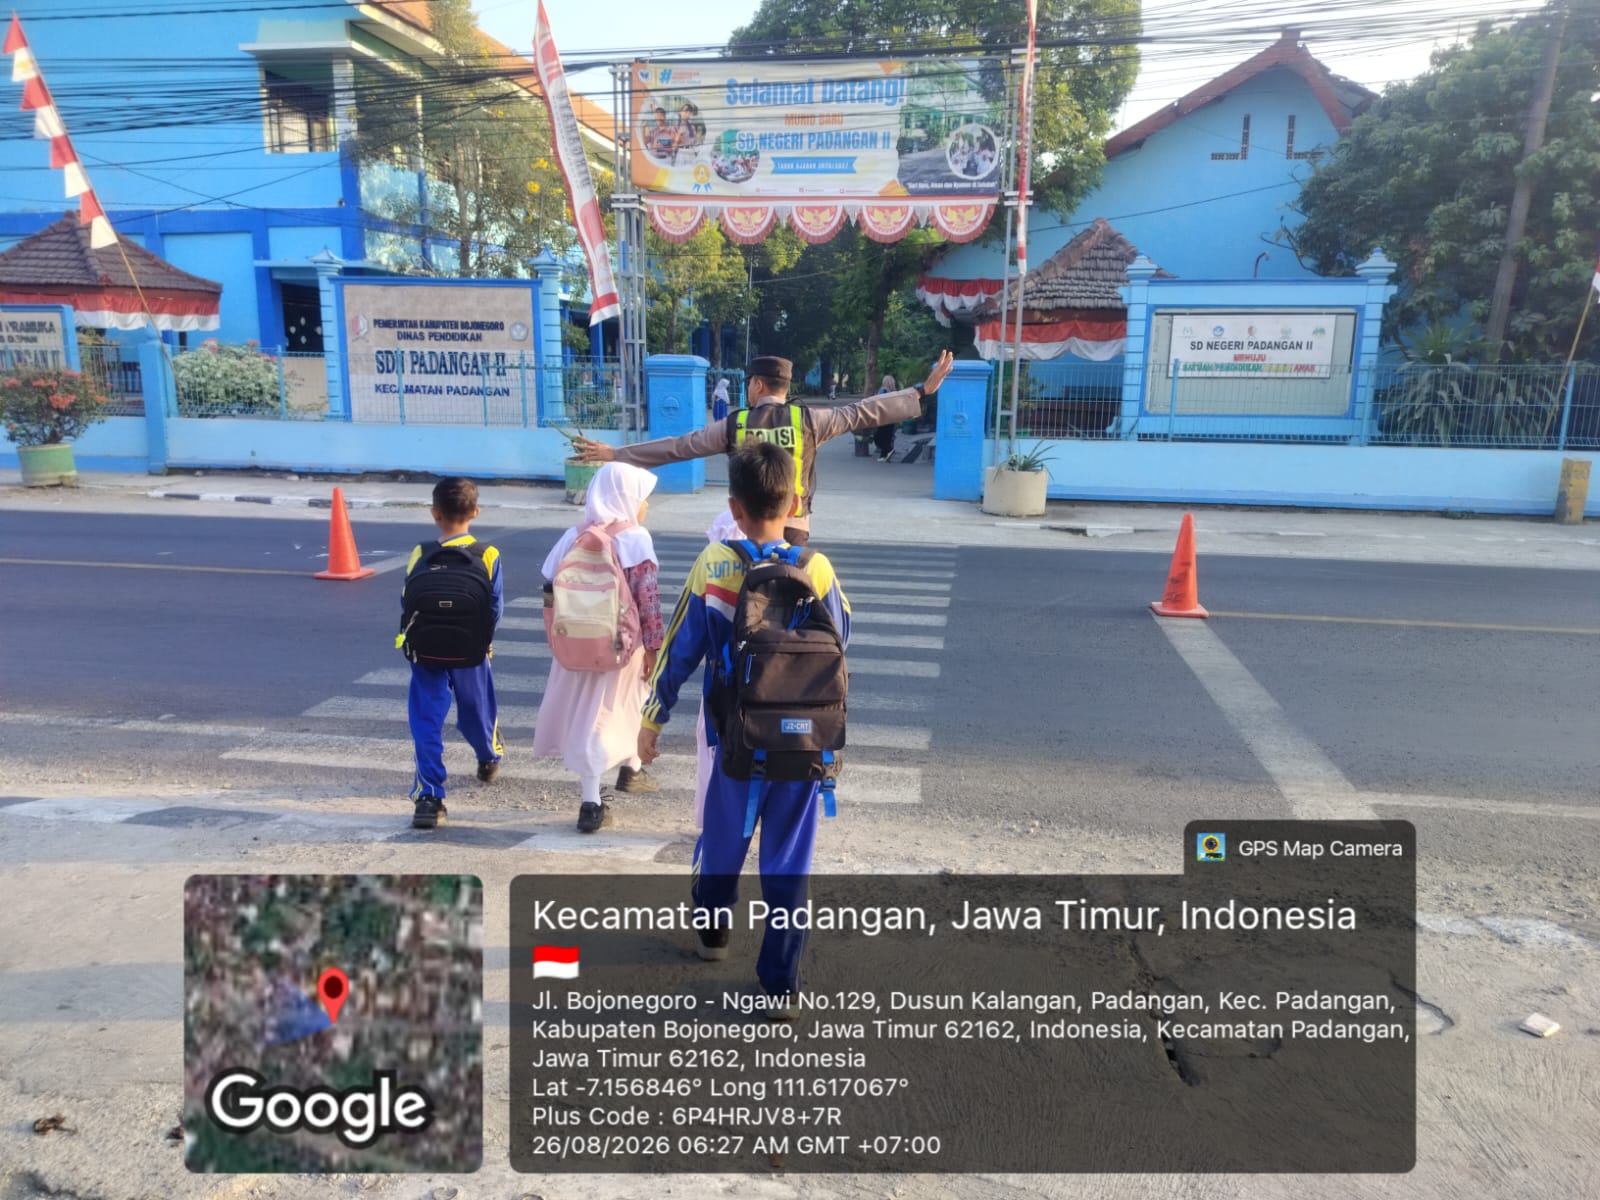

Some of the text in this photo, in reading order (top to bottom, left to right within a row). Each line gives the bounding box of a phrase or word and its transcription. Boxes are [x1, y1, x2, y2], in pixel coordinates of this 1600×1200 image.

[725, 77, 907, 107] Selamat Datang!
[737, 131, 891, 150] SD NEGERI PADANGAN II
[419, 319, 460, 330] KABUPATEN
[460, 320, 505, 331] BOJONEGORO
[397, 331, 482, 342] DINAS PENDIDIKAN
[1190, 341, 1313, 350] SD NEGERI PADANGAN II
[375, 350, 507, 376] SDN PADANGAN II
[375, 384, 510, 397] KECMATAN PADANGAN
